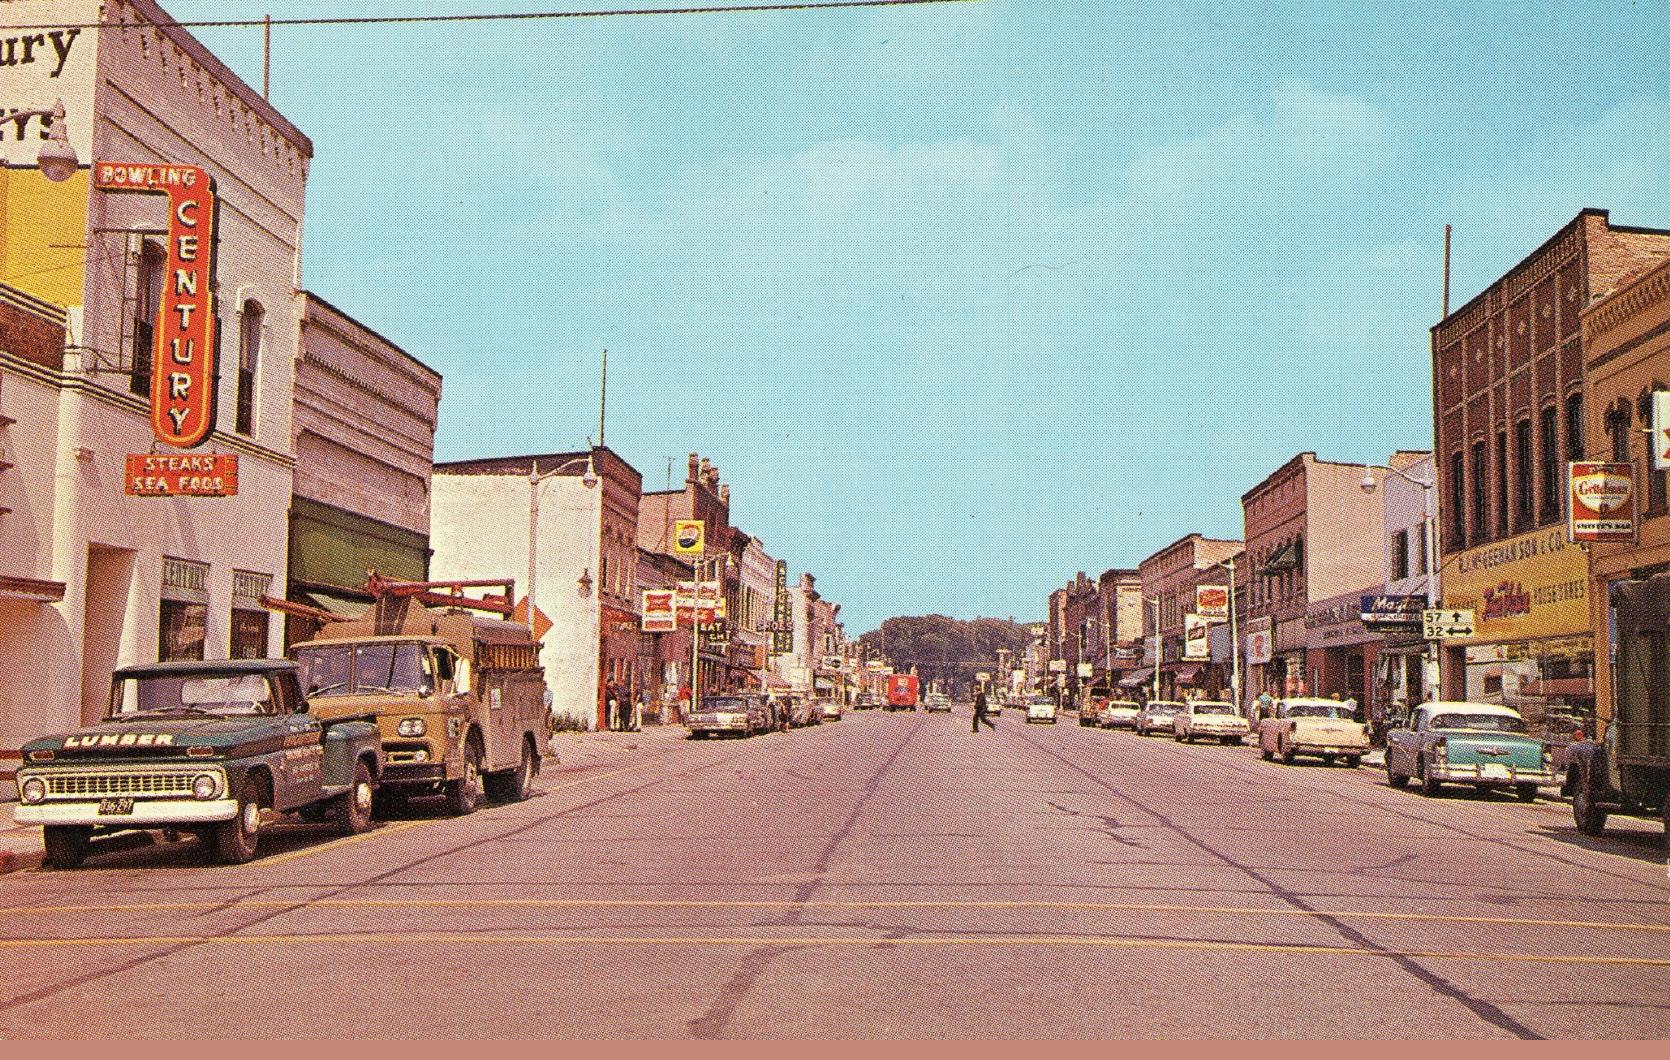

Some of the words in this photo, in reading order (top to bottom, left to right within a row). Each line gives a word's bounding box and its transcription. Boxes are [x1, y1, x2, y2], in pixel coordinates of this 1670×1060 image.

[101, 166, 197, 186] BOWLING
[167, 200, 199, 434] CENTURY
[145, 457, 214, 472] STEAKS
[132, 477, 169, 491] SEA
[178, 477, 224, 491] FOOD
[1425, 612, 1442, 622] 57
[1427, 627, 1444, 637] 32
[63, 733, 173, 749] LUMBER
